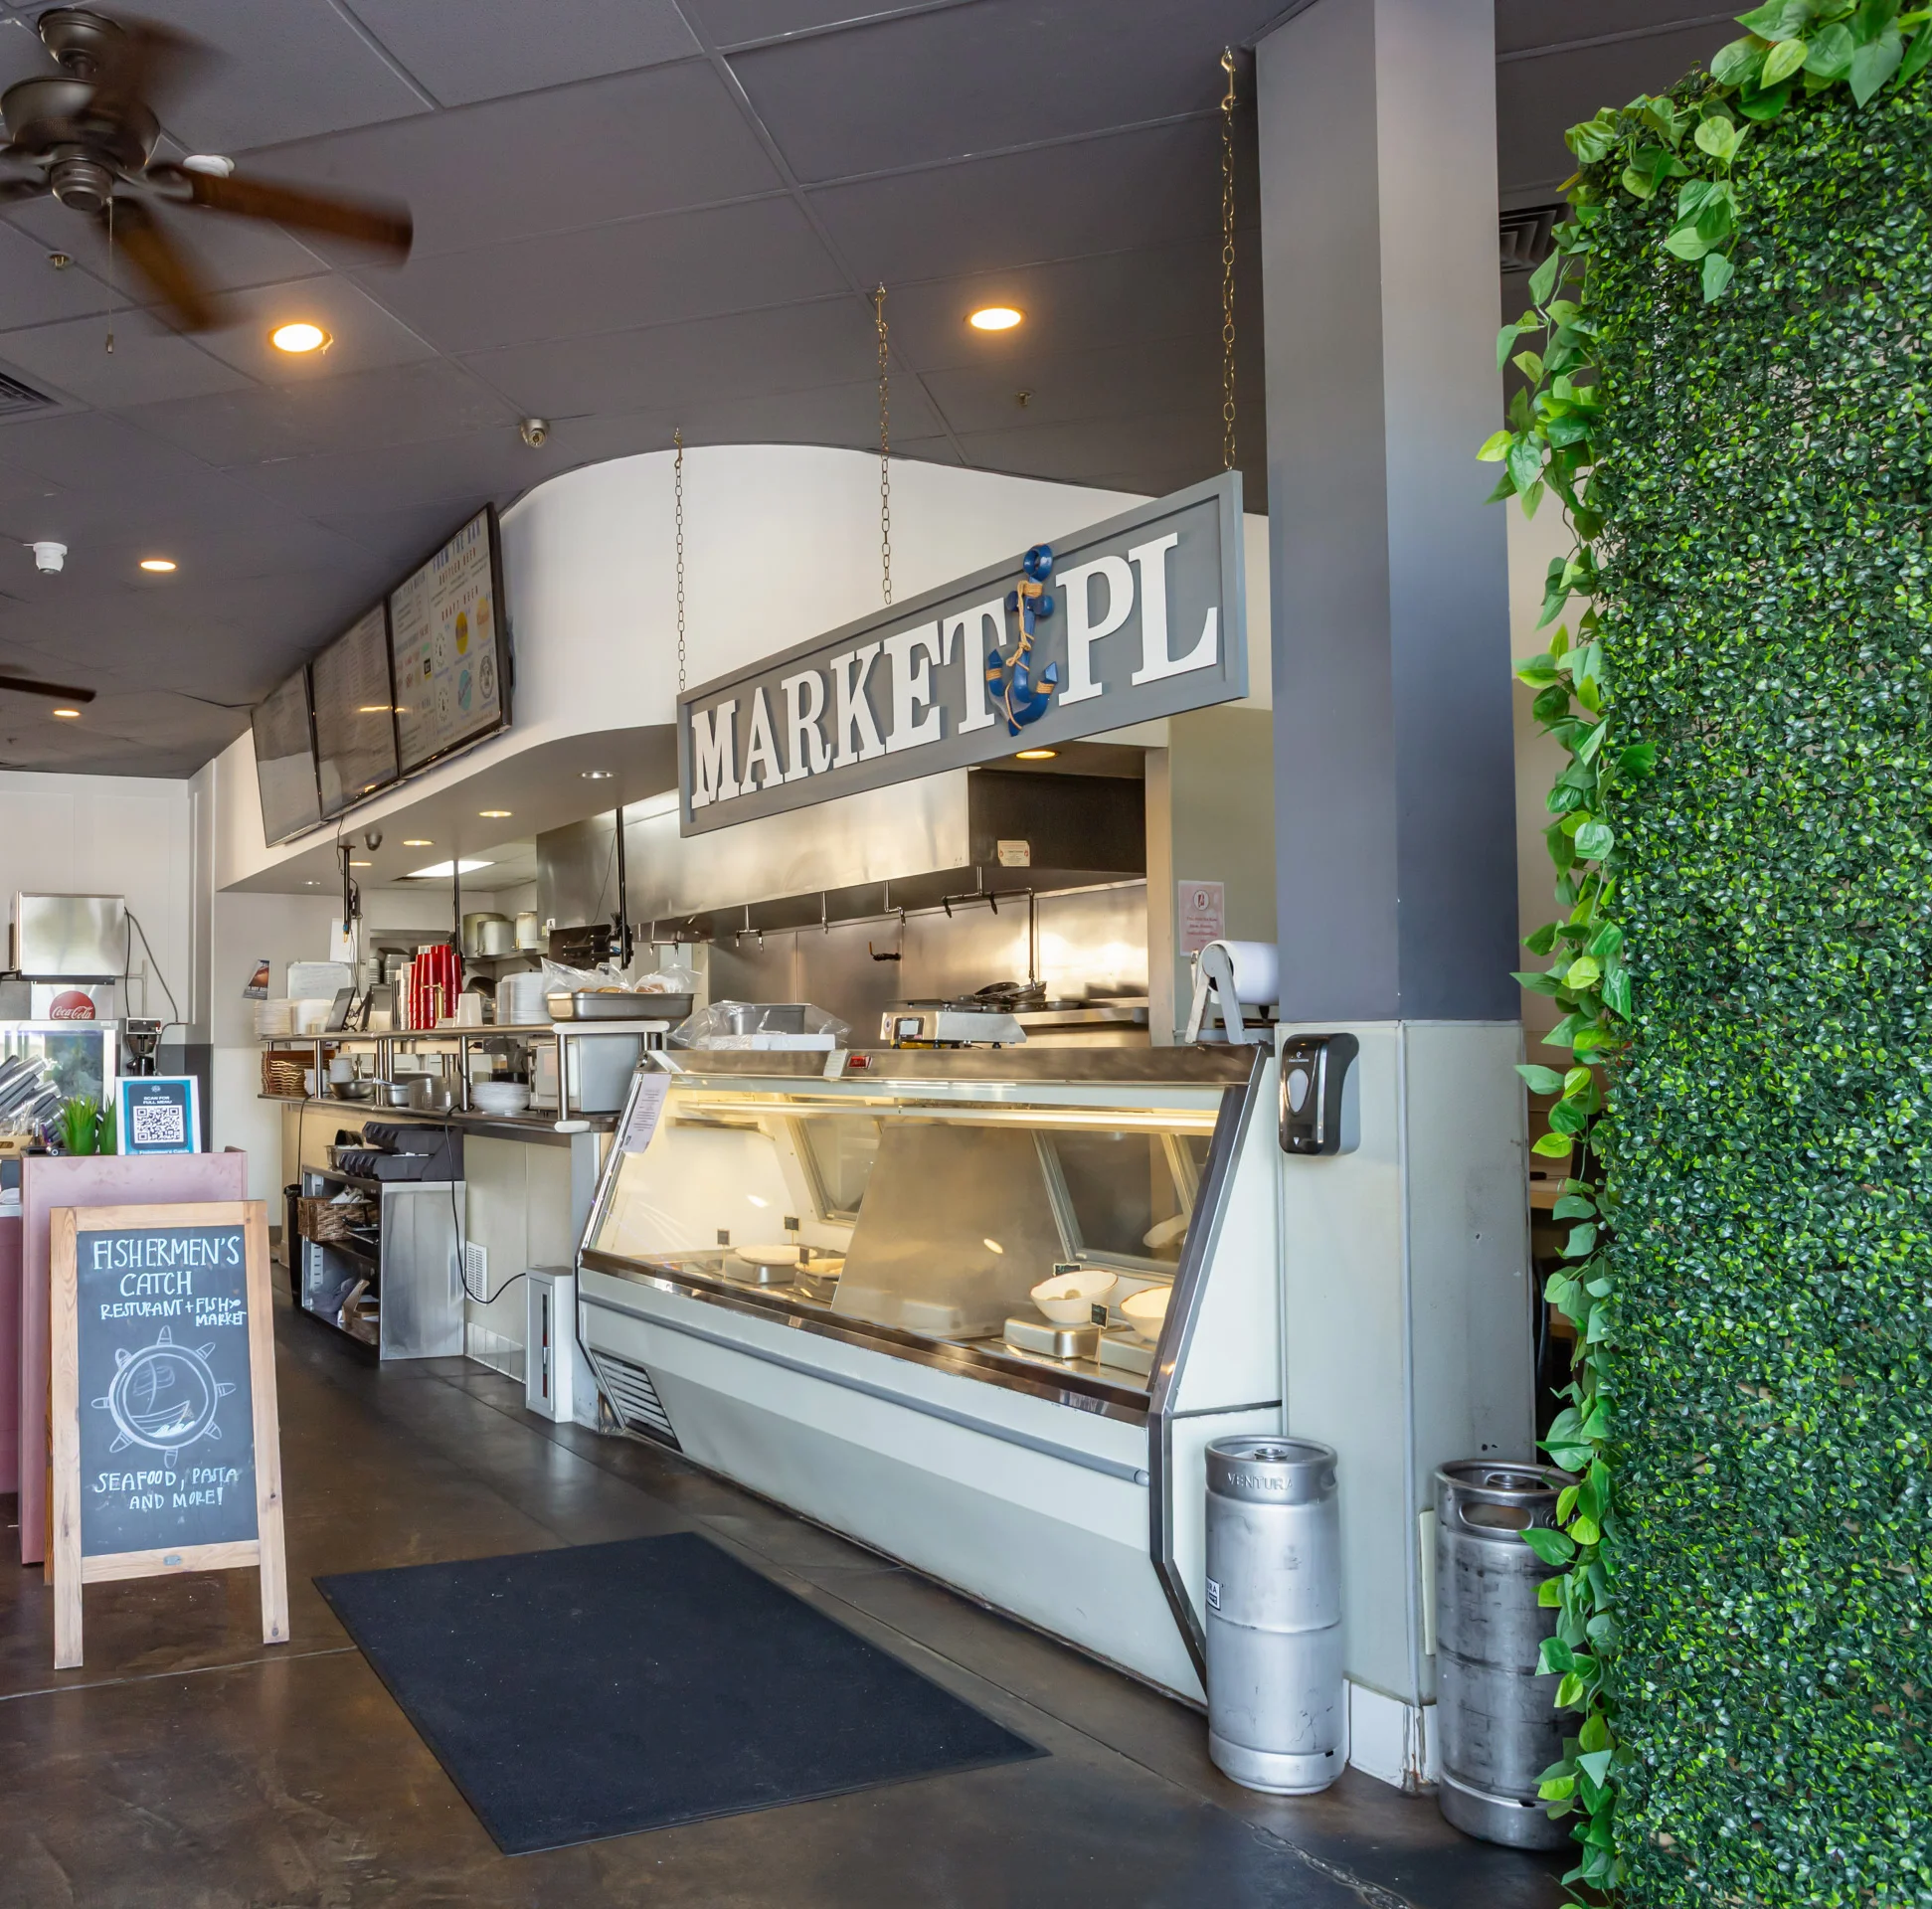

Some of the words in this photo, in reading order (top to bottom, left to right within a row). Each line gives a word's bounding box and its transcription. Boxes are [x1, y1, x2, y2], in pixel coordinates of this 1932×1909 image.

[691, 597, 1008, 809] MARKET
[1055, 532, 1218, 707] PL
[93, 1236, 241, 1270] FISHERMEN'S
[119, 1271, 193, 1297] CATCH
[100, 1299, 184, 1320] RESTURANT
[195, 1297, 229, 1313] FISH
[195, 1310, 247, 1327] MARKET
[93, 1470, 185, 1493] SEAFOOD,
[192, 1466, 240, 1484] PASTA
[1227, 1472, 1294, 1491] VENTURA
[129, 1492, 164, 1510] AND
[172, 1486, 224, 1508] MORE!
